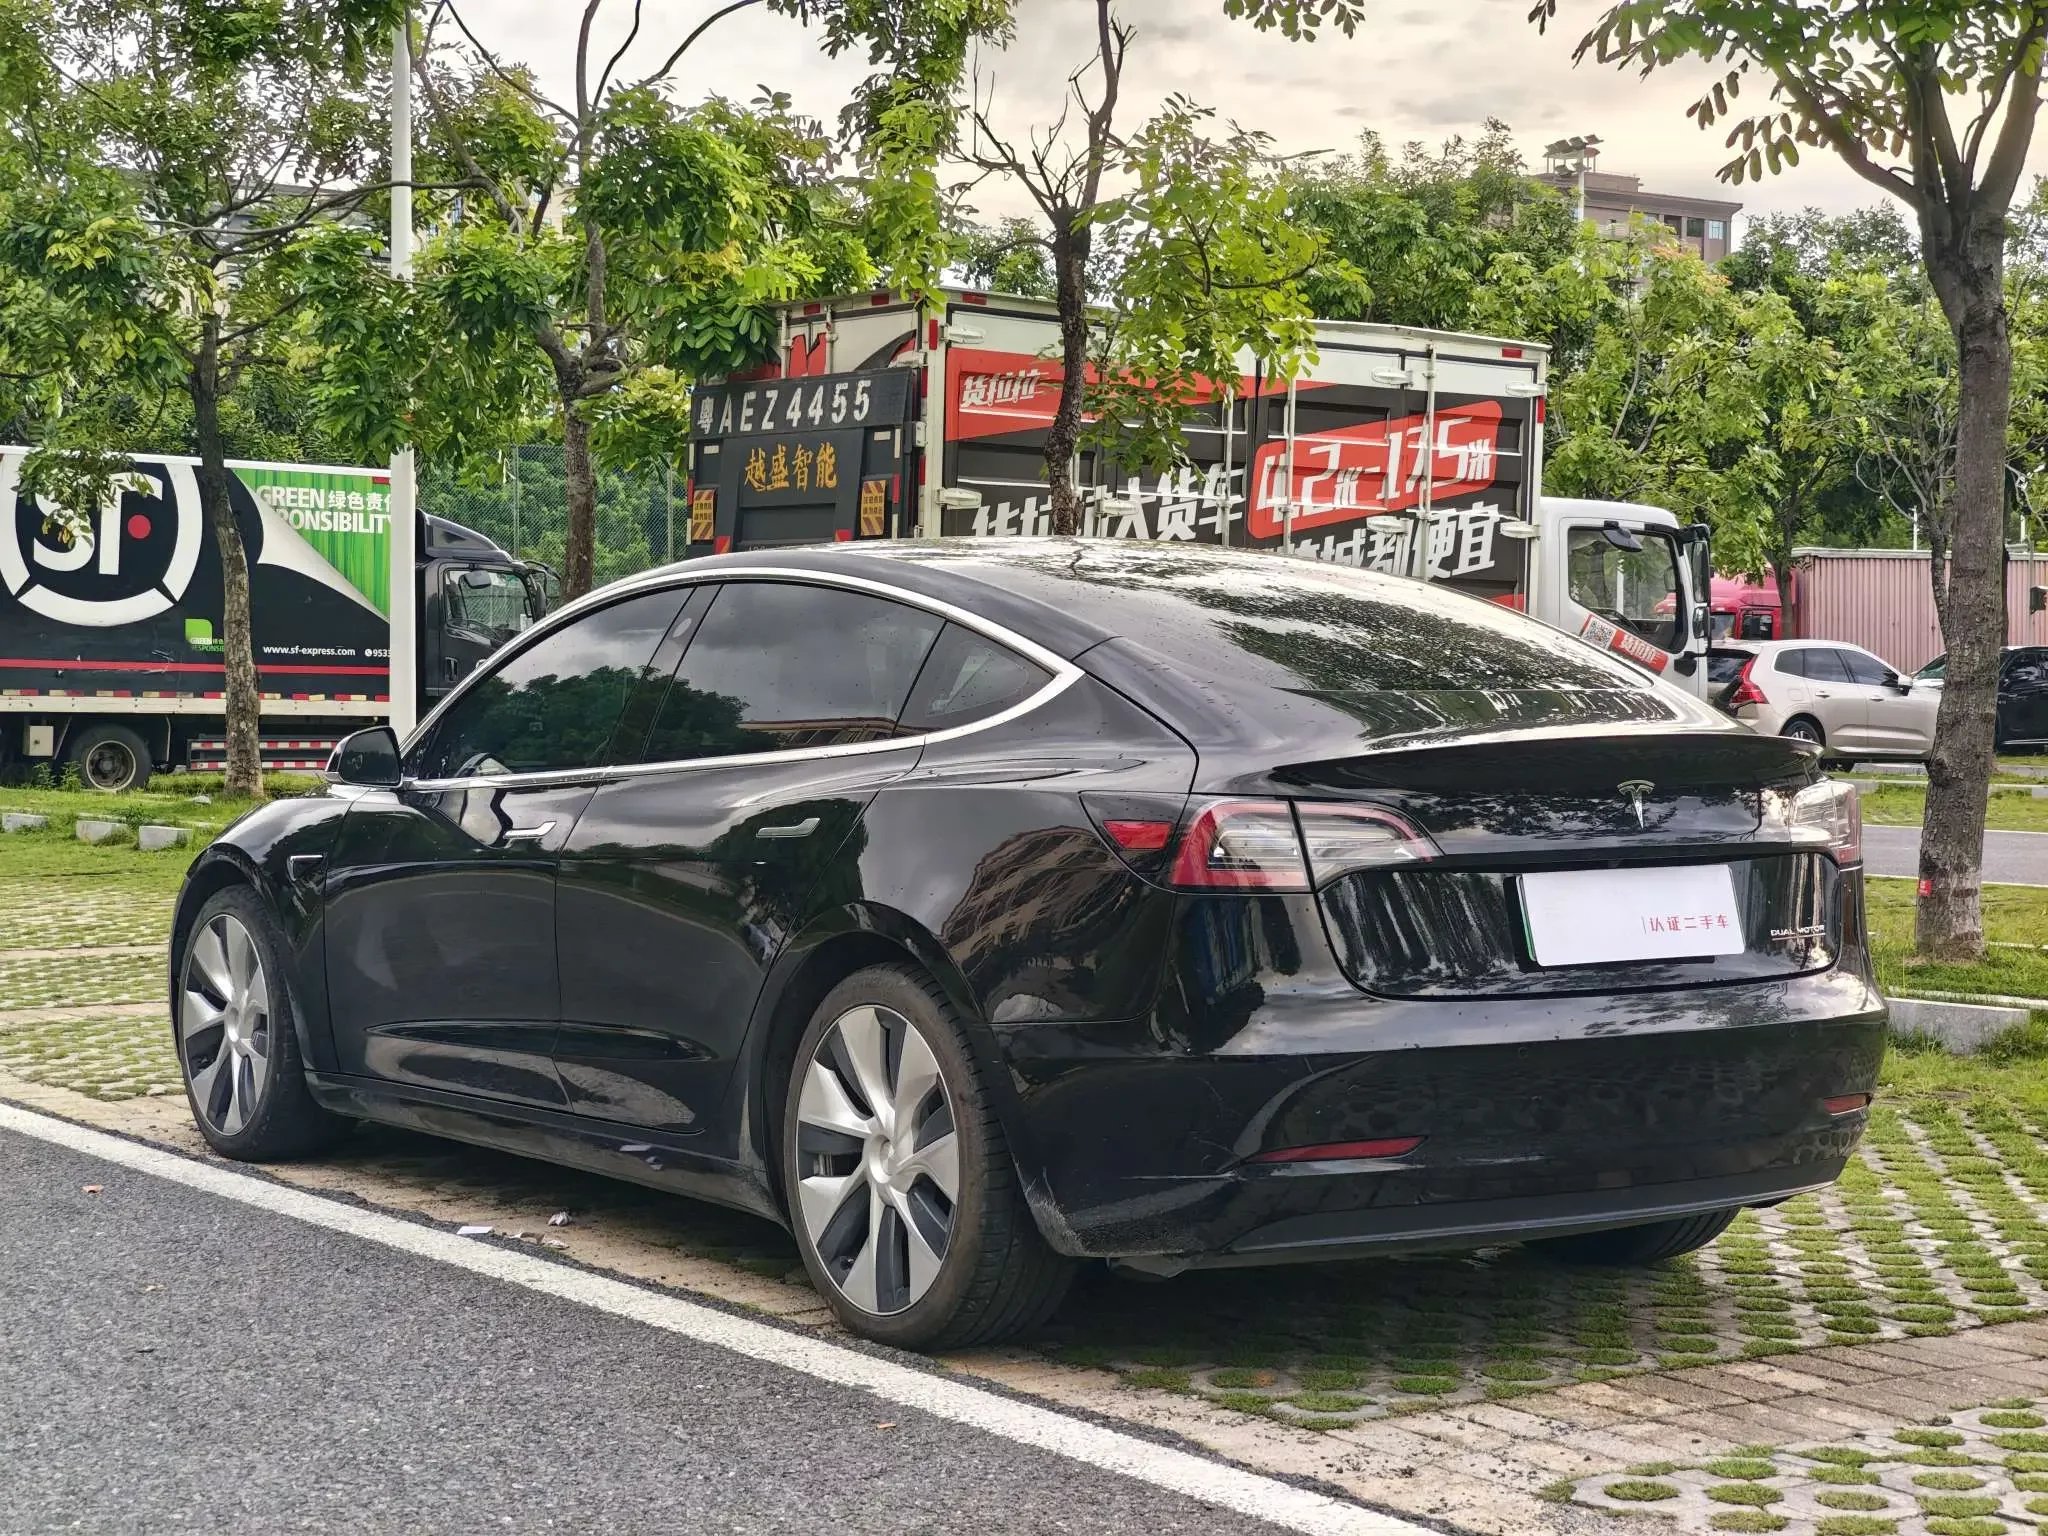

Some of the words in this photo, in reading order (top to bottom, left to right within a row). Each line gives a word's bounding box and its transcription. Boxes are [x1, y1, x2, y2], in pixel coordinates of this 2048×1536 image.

[960, 369, 1044, 407] 货拉拉
[697, 379, 872, 435] 粤AEZ4455
[744, 441, 838, 493] 越盛智能
[257, 485, 325, 509] GREEN
[263, 645, 356, 657] www.sf-express.com
[1649, 914, 1729, 932] 认证二手车
[1770, 928, 1796, 937] DUAL
